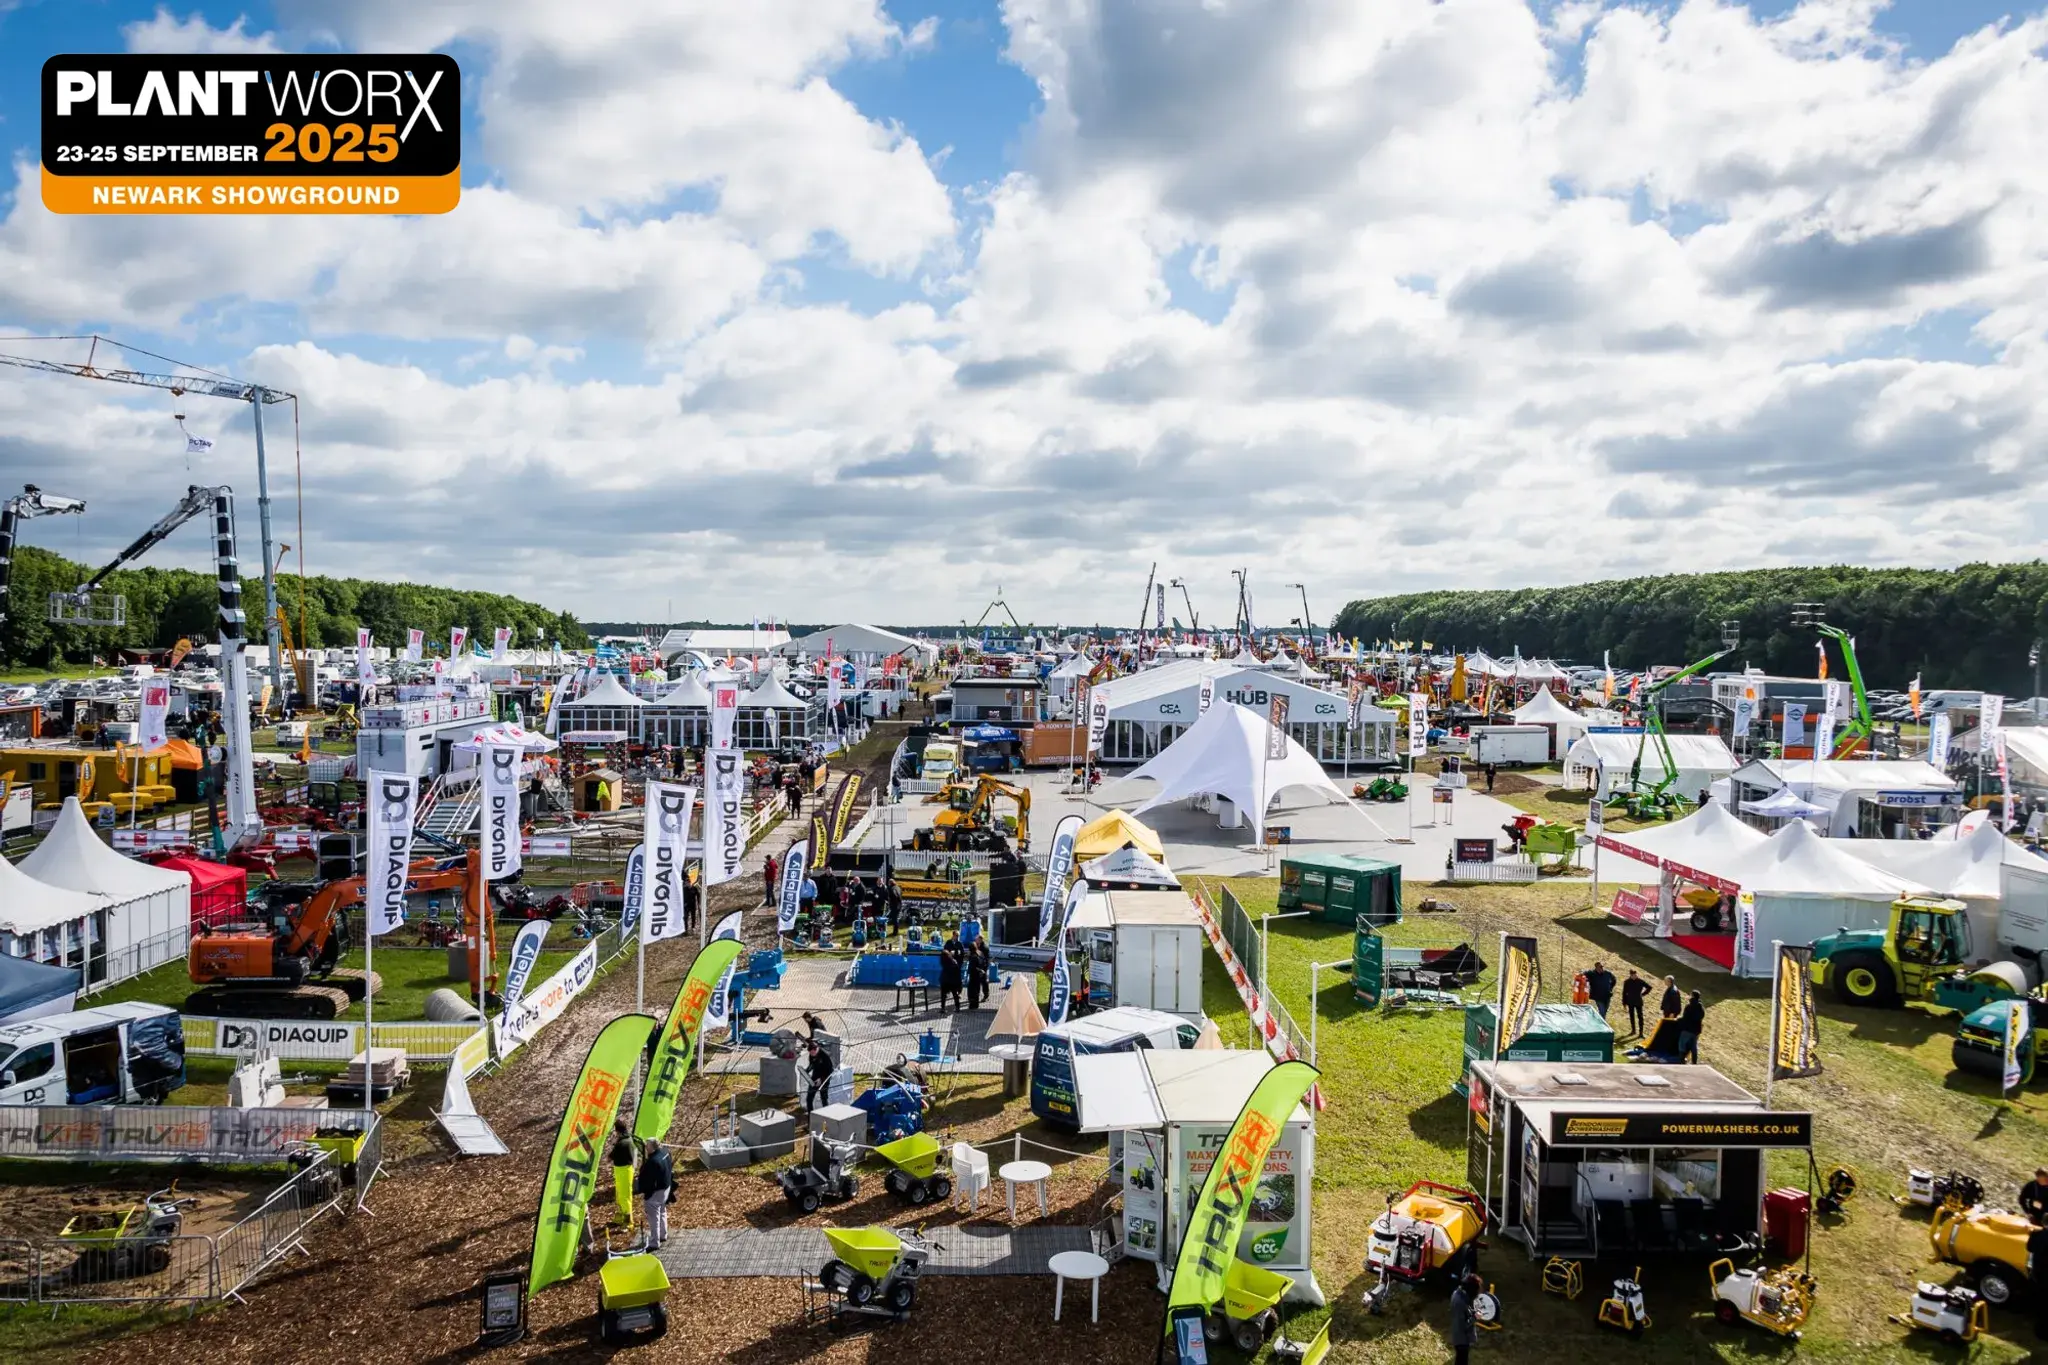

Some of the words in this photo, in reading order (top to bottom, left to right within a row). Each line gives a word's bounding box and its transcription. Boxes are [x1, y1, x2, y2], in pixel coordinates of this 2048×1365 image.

[1227, 690, 1268, 706] HUB
[1159, 704, 1181, 714] CEA
[1315, 704, 1337, 714] CEA
[1092, 704, 1107, 743] HUB
[1413, 709, 1425, 749] HUB
[1887, 793, 1926, 804] probst
[384, 835, 407, 926] DIAQUIP
[783, 859, 801, 917] mabey
[626, 861, 644, 923] mabey
[565, 976, 574, 995] to
[268, 1026, 349, 1044] DIAQUIP
[1661, 1124, 1800, 1135] POWERWASHERS.CO.UK
